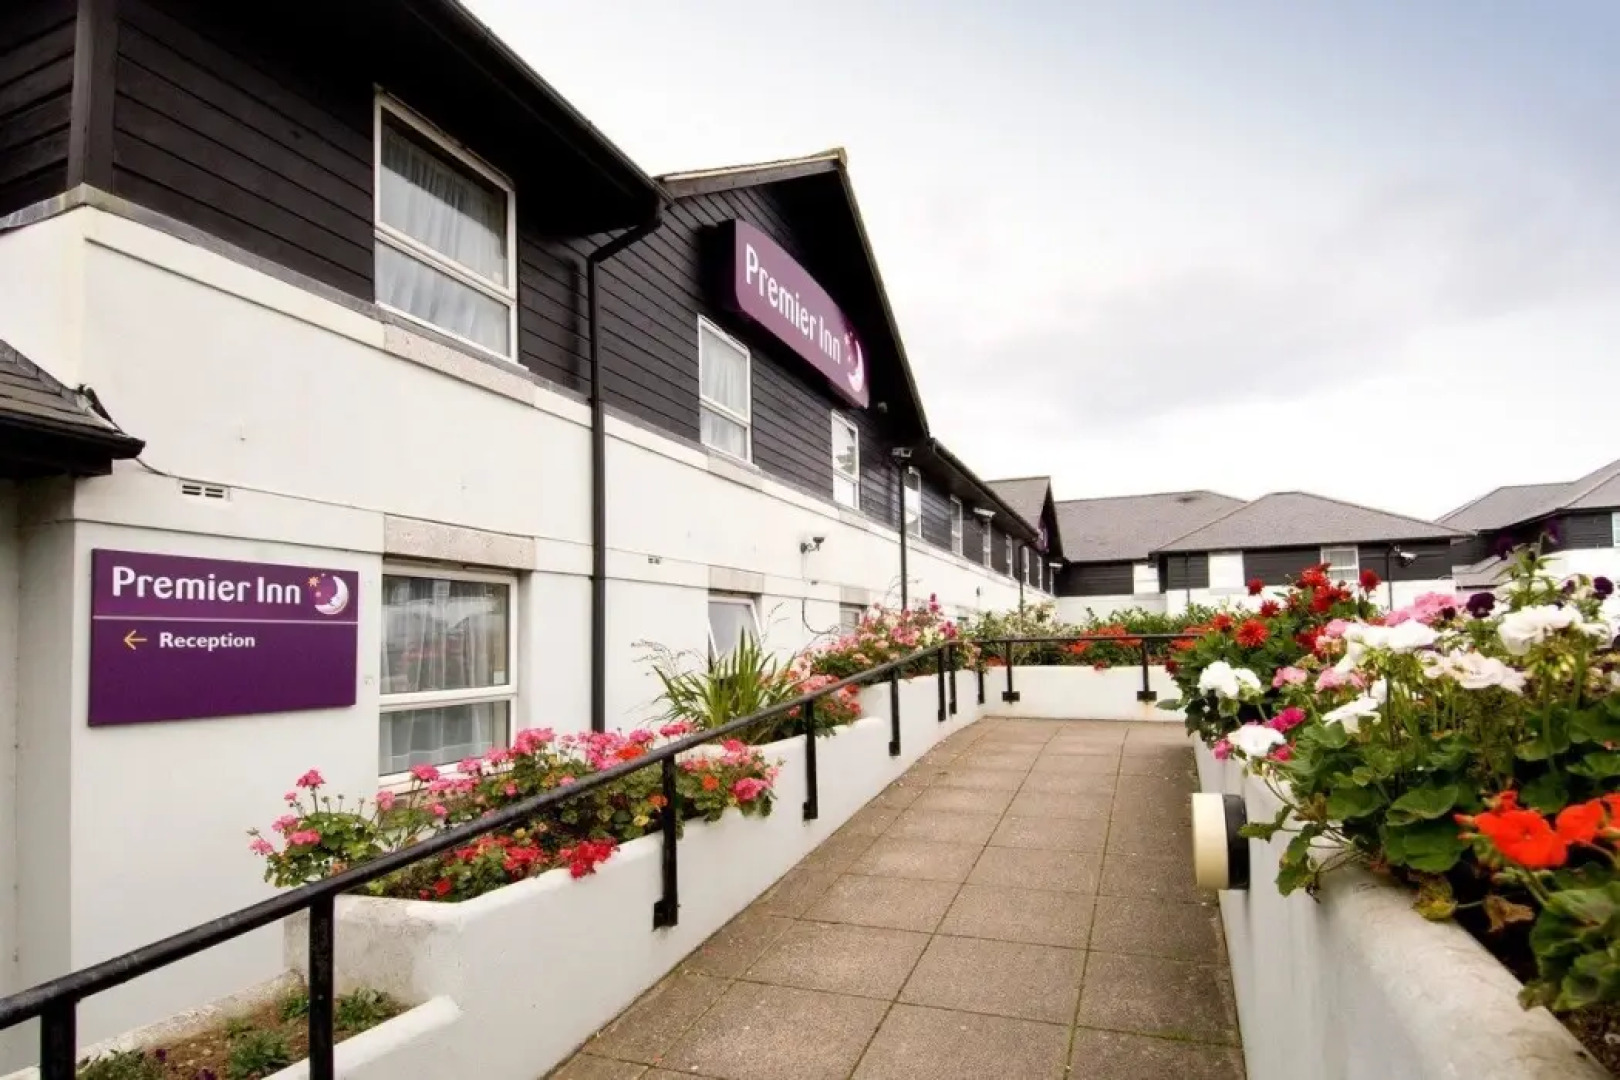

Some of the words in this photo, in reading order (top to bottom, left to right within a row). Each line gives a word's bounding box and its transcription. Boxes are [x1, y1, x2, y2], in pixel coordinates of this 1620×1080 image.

[745, 243, 816, 340] Premier
[819, 316, 840, 364] Inn
[112, 566, 251, 602] Premier
[257, 577, 301, 604] Inn
[159, 632, 256, 652] Reception
